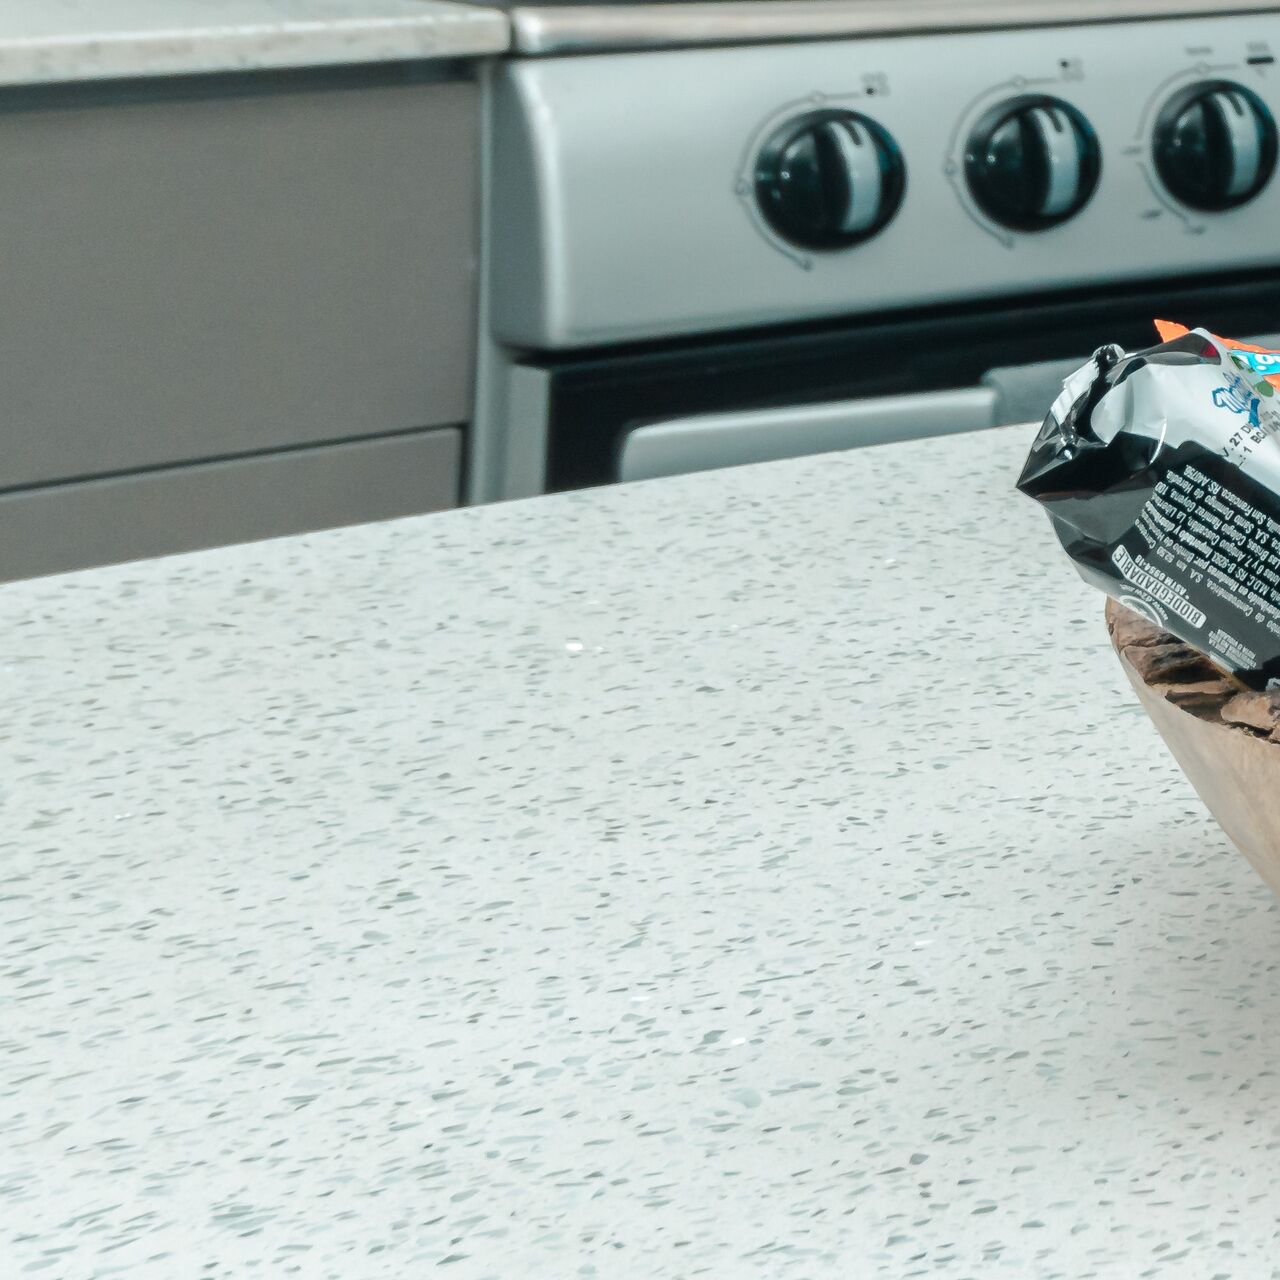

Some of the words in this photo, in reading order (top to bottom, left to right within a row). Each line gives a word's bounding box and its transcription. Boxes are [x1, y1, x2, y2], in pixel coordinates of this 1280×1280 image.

[1153, 480, 1170, 496] 100
[1201, 492, 1236, 521] Domingo
[1249, 508, 1267, 525] San
[1218, 520, 1248, 547] Colegio
[1230, 514, 1255, 535] Santo
[1170, 541, 1195, 562] Bimbo
[1176, 527, 1215, 558] Importado
[1216, 536, 1247, 562] Antiguo
[1204, 564, 1239, 591] Honduras
[1260, 568, 1280, 586] lotes
